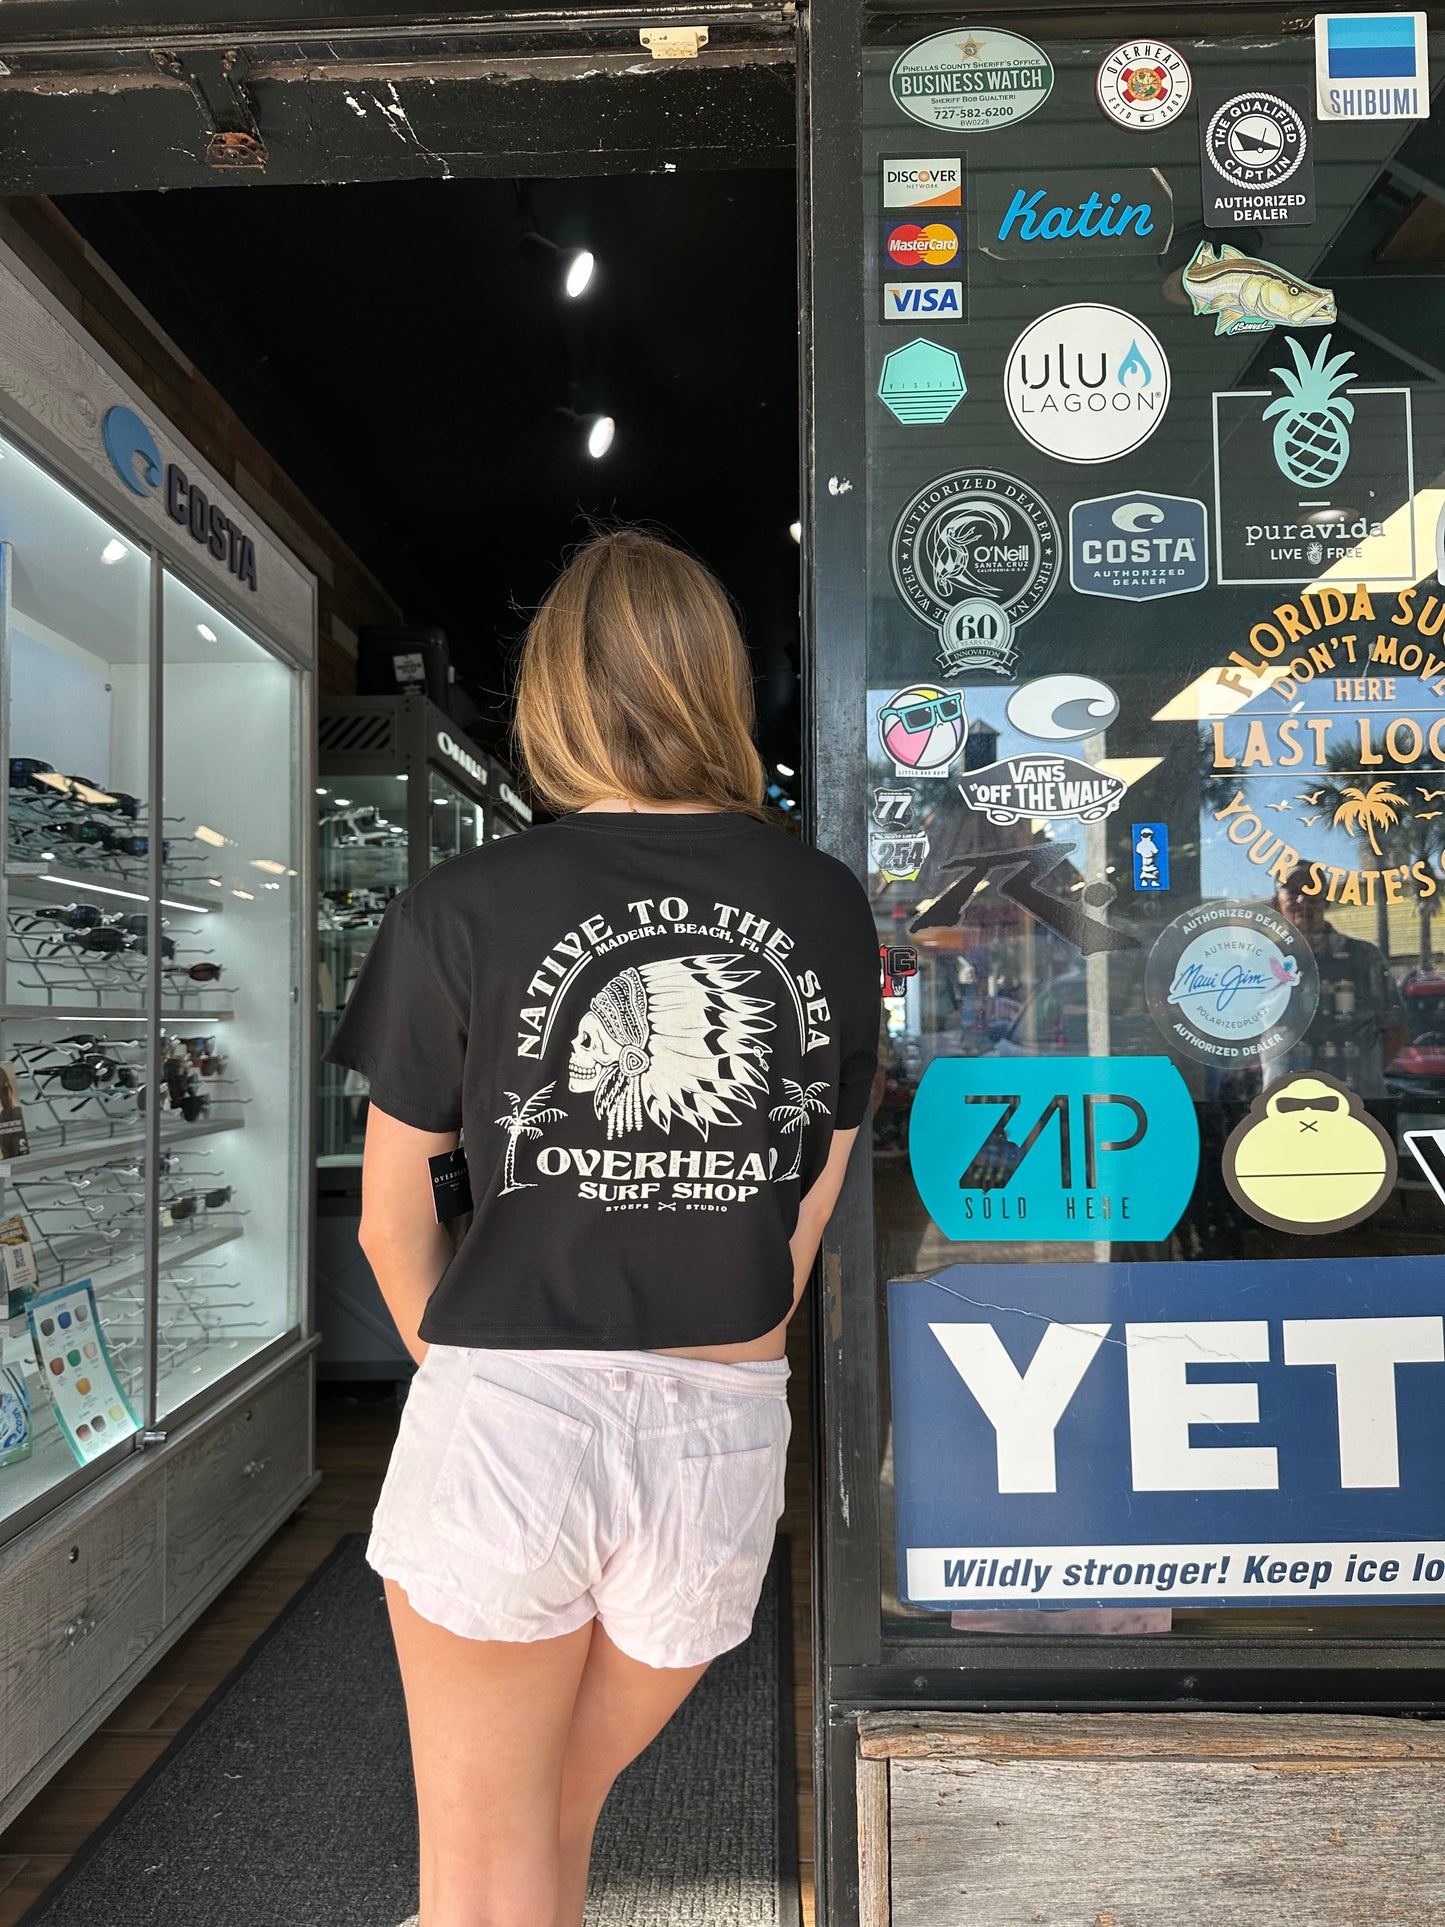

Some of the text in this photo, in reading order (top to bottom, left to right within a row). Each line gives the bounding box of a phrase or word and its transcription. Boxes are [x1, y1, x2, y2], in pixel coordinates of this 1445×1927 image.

[902, 64, 940, 72] PINELLAS
[941, 62, 971, 71] COUNTY
[972, 60, 1012, 69] SHERIFF'S
[1106, 45, 1181, 75] OVERHEAD
[901, 69, 1042, 95] BUSINESS WATCH
[979, 94, 1016, 102] GUALTIERI
[1108, 93, 1183, 119] ESTD 2004
[1329, 88, 1418, 116] SHIBUMI
[934, 106, 1014, 119] 727-582-6200
[1215, 101, 1297, 148] THE QUALIFIED
[887, 170, 957, 183] DISCOVER
[1224, 156, 1291, 180] CAPTAIN
[1214, 194, 1306, 209] AUTHORIZED
[1233, 208, 1288, 221] DEALER
[997, 189, 1154, 241] Katin
[889, 238, 957, 252] MasterCard
[887, 288, 959, 312] VISA
[1021, 343, 1106, 390] ulu
[901, 478, 1051, 546] AUTHORIZED DEALER
[167, 463, 257, 591] COSTA
[1245, 516, 1386, 546] puravida
[974, 545, 1029, 562] O'Neill
[1082, 538, 1196, 564] COSTA
[1271, 548, 1362, 560] LIVE FREE
[1094, 569, 1185, 577] AUTHORIZED
[1113, 578, 1167, 586] DEALER
[902, 564, 931, 611] WATER
[1009, 562, 1053, 621] FIRST NA
[956, 614, 998, 641] 60
[954, 648, 1001, 660] INNOVATION
[1216, 583, 1445, 699] FLORIDA SU
[1271, 635, 1357, 702] DON'T
[1336, 677, 1396, 701] HERE
[1212, 718, 1333, 767] LAST
[1008, 760, 1065, 783] VANS
[878, 796, 912, 819] 77
[1015, 784, 1057, 810] THE
[878, 841, 925, 870] 254
[1214, 790, 1437, 906] YOUR STATE'S
[595, 923, 760, 956] MADEIRA BEACH, FL
[1182, 909, 1294, 946] AUTHORIZED DEALER
[1204, 941, 1263, 958] AUTHENTIC
[517, 896, 831, 1060] NATIVE TO THE SEA
[1174, 964, 1273, 1011] Maui Jim
[1173, 1023, 1284, 1057] AUTHORIZED DEALER
[959, 1094, 1148, 1190] ZAP
[578, 1181, 759, 1203] SURF SHOP
[685, 1204, 729, 1213] STUDIO
[966, 1197, 1130, 1219] SOLD HERE
[927, 1316, 1445, 1494] YET
[943, 1559, 1052, 1593] Wildly
[1063, 1556, 1229, 1591] stronger!
[1243, 1554, 1333, 1590] Keep
[1344, 1553, 1400, 1583] ice
